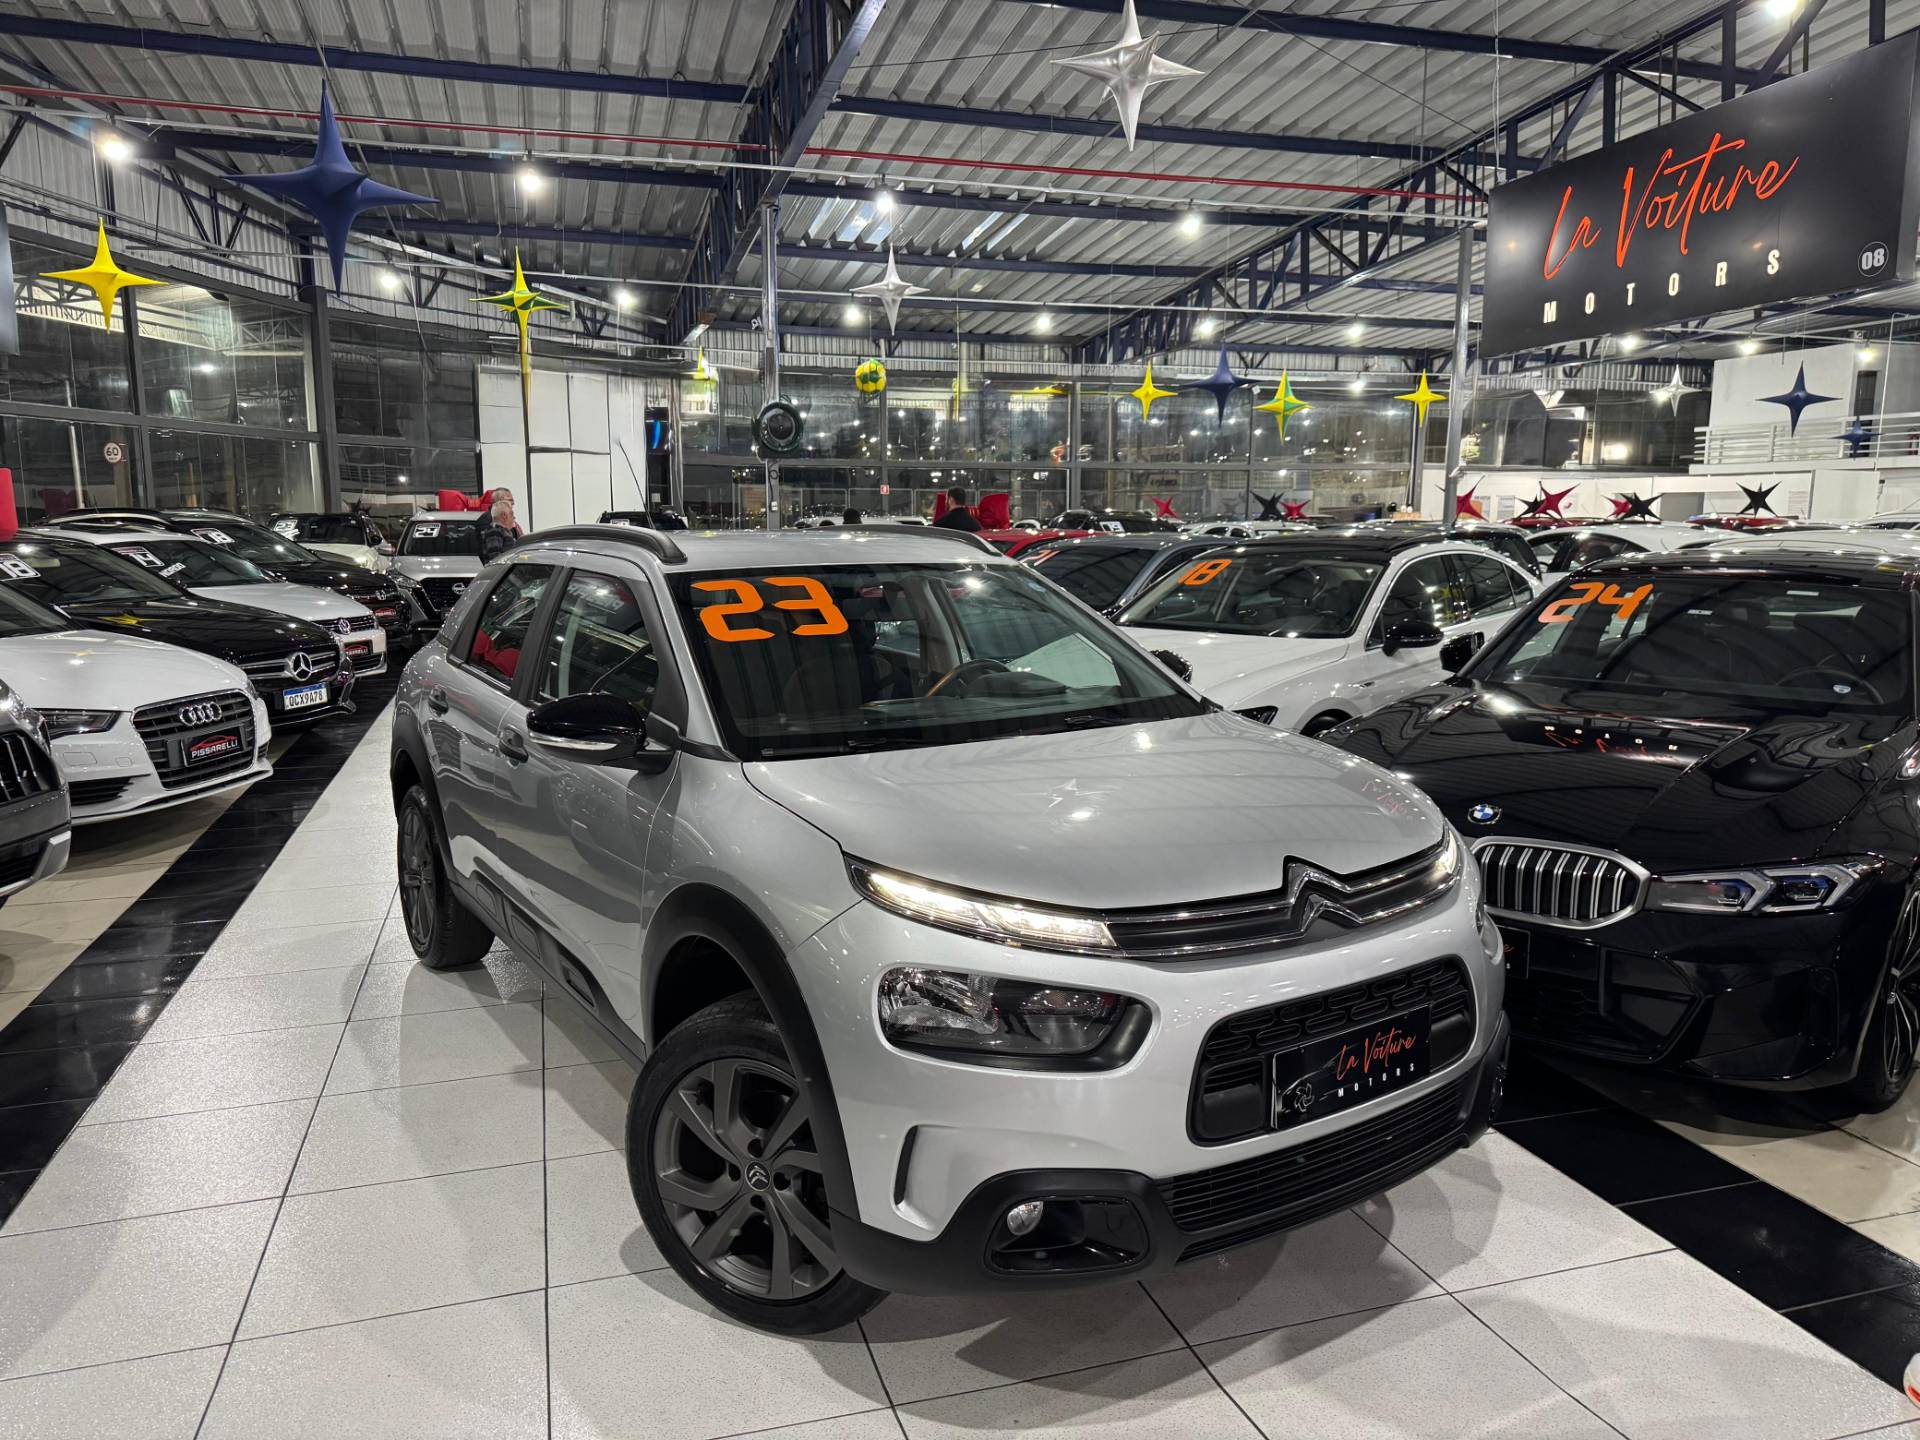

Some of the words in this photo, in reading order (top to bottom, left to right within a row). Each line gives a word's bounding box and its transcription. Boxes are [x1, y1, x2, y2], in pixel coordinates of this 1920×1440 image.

[1543, 185, 1601, 280] La
[1615, 132, 1800, 269] Voiture
[1860, 248, 1886, 272] 08
[1543, 248, 1781, 324] MOTORS
[106, 447, 119, 456] 60
[208, 530, 235, 544] 18
[415, 527, 439, 537] 24
[1177, 559, 1233, 586] 18
[691, 575, 849, 642] 23
[1537, 581, 1654, 624] 24
[191, 739, 238, 759] PISSARELLI
[1336, 1044, 1360, 1081] La
[1364, 1027, 1417, 1074] Voiture
[1337, 1062, 1415, 1097] MOTORS
